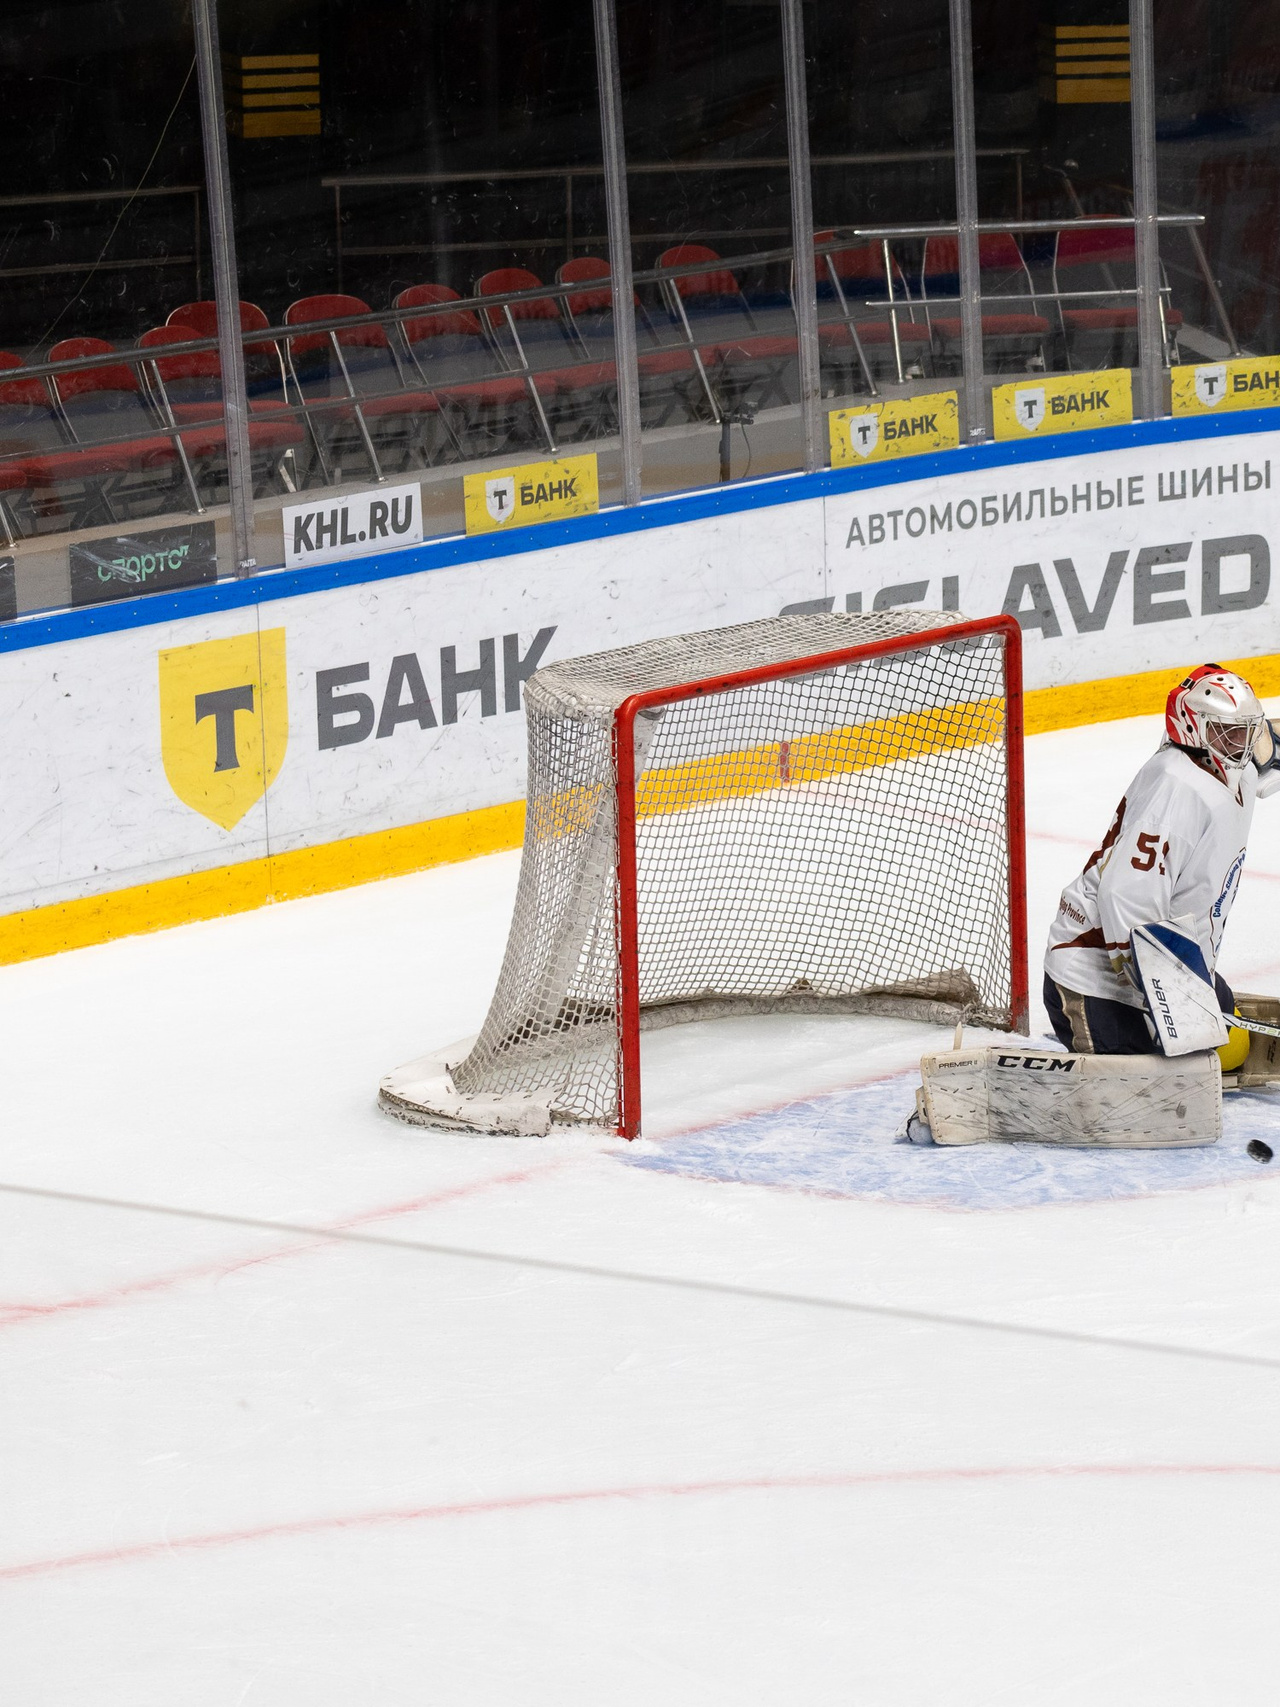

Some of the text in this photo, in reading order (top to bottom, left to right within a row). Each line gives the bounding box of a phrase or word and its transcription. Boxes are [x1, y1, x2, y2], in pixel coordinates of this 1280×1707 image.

[1051, 390, 1111, 416] БАНК
[883, 414, 939, 441] БАНК
[520, 477, 578, 506] БАНК
[845, 460, 1272, 549] АВТОМОБИЛЬНЫЕ ШИНЫ
[293, 494, 414, 555] KHL.RU
[316, 625, 559, 751] БАНК
[938, 1060, 973, 1069] PREMIER
[997, 1054, 1077, 1073] CCM
